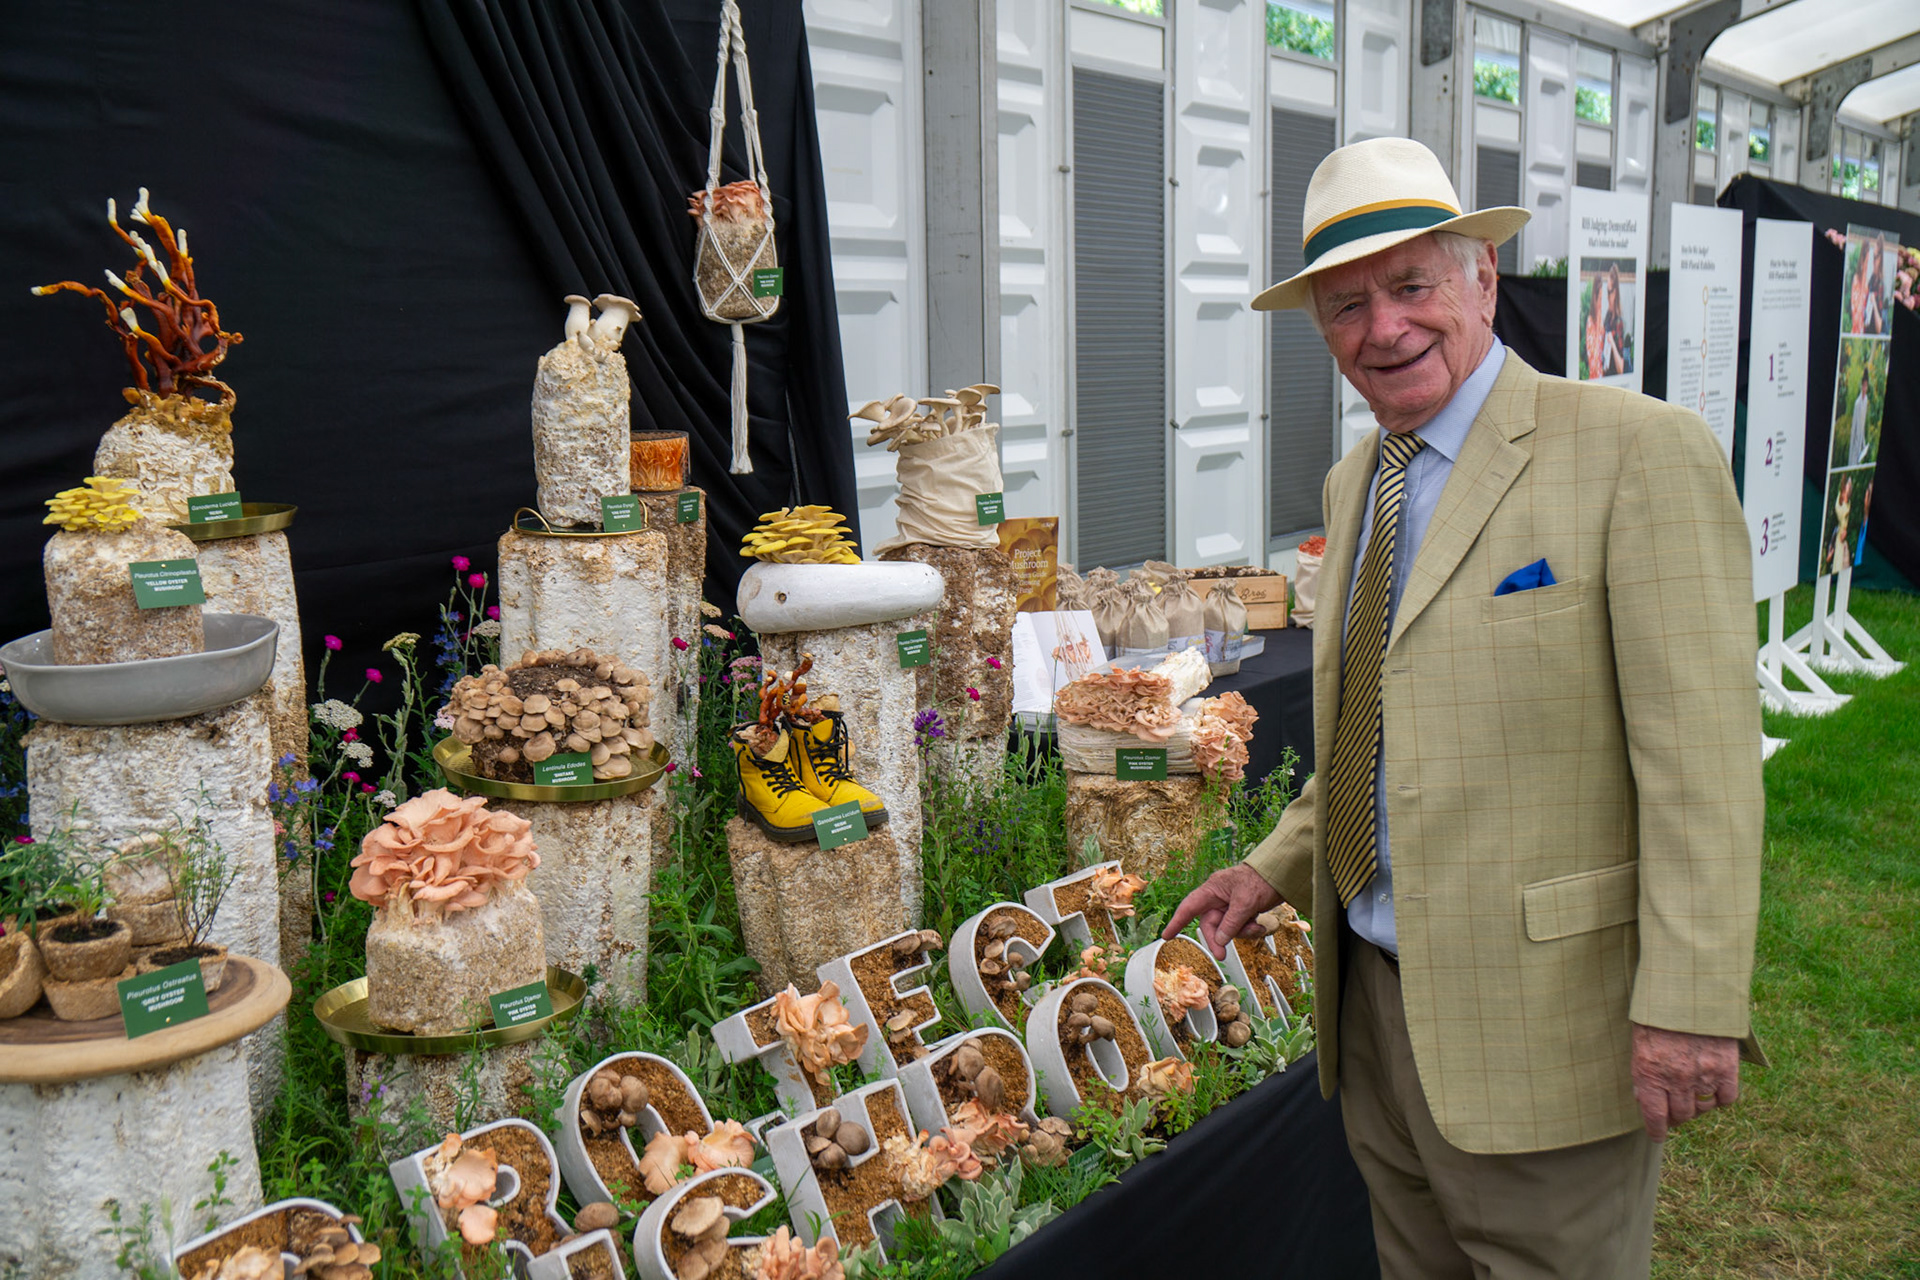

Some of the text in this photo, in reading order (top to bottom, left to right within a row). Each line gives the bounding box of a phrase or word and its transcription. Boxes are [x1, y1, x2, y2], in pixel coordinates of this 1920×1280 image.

[1591, 217, 1607, 236] Judging
[1609, 218, 1637, 237] Demystified
[1769, 353, 1774, 382] 1
[1765, 437, 1773, 467] 2
[191, 500, 239, 511] Ganoderma Lucidum
[1760, 517, 1769, 556] 3
[1014, 549, 1041, 560] Project
[1241, 587, 1267, 601] Bros
[542, 761, 586, 772] Lentinula Edodes
[816, 809, 860, 826] Ganoderma Lucidum
[126, 973, 197, 1000] Pleurotus Ostreatus
[160, 987, 185, 1000] OYSTER
[499, 992, 542, 1010] Pleurotus Djamor
[518, 1003, 537, 1013] OYSTER
